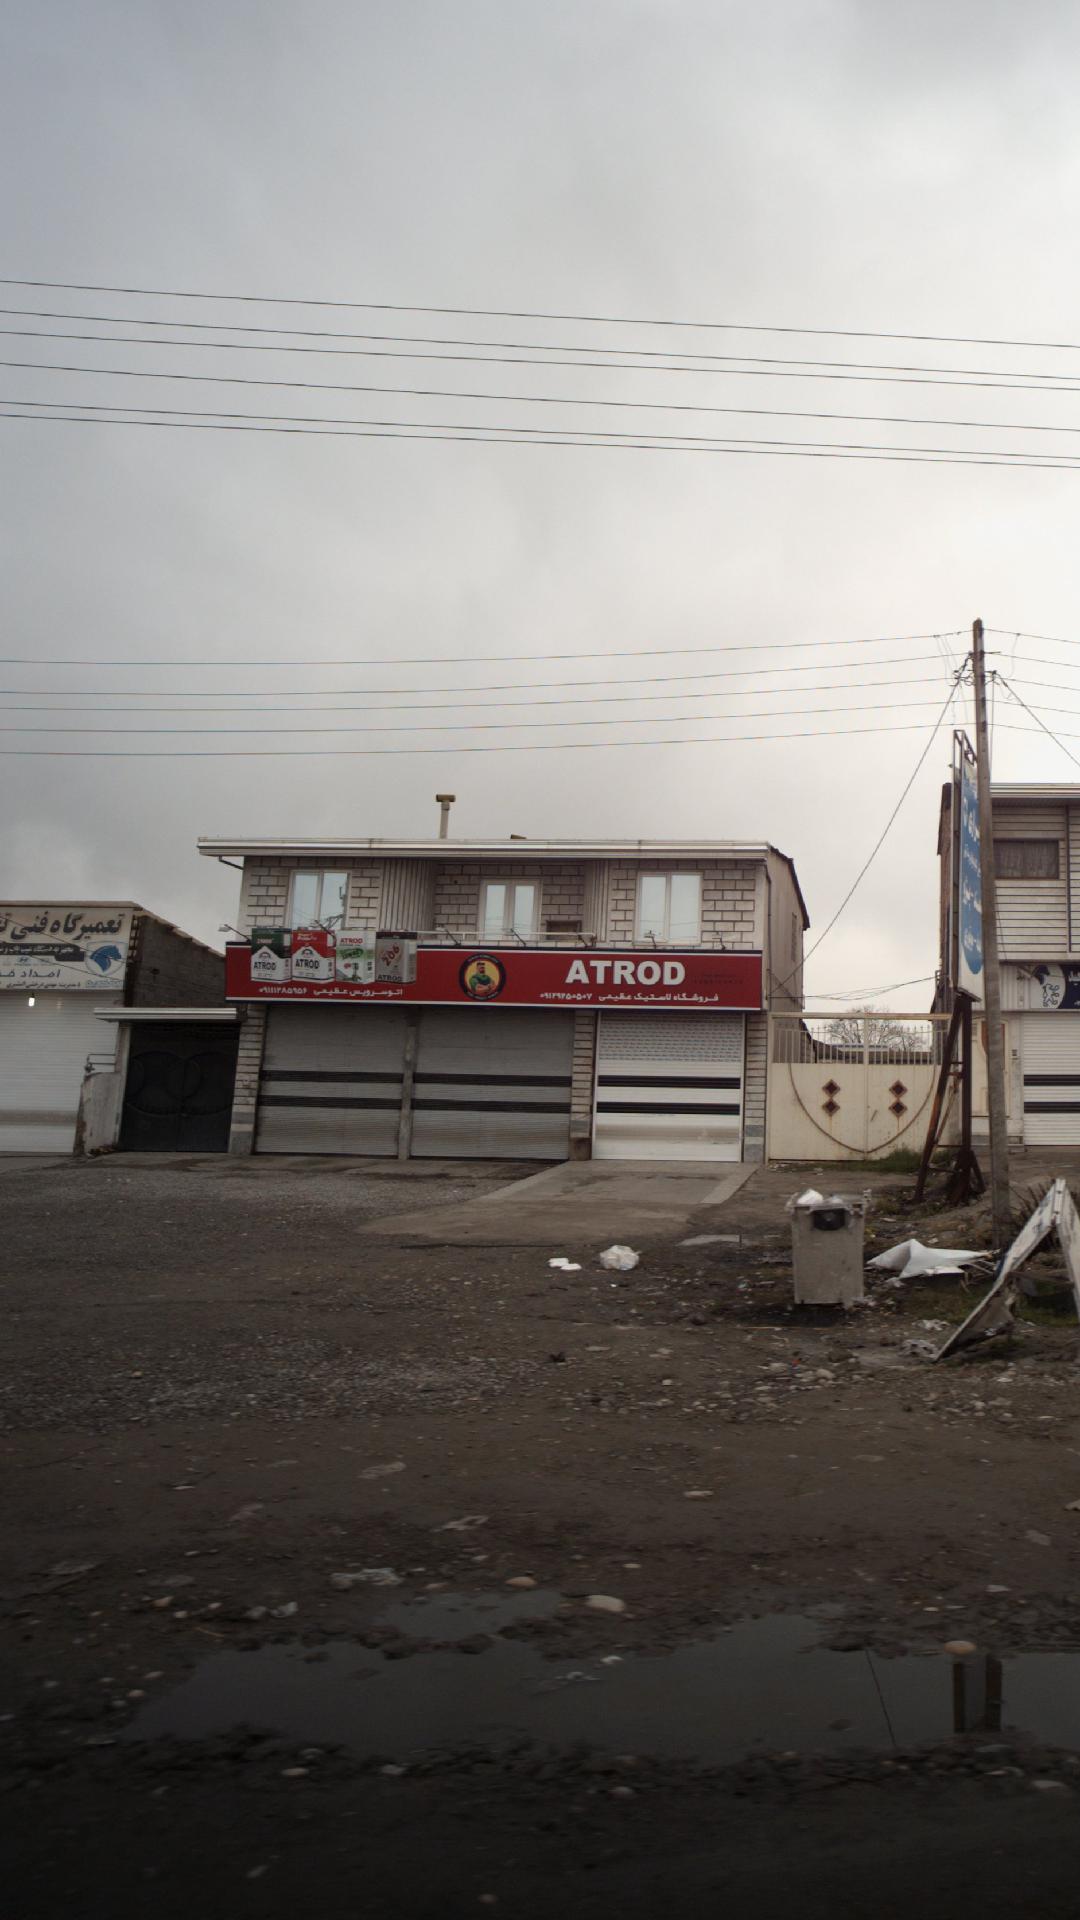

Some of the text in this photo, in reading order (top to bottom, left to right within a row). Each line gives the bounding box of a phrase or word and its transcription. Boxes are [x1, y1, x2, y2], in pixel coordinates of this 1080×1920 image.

[10, 911, 48, 940] فنی
[50, 912, 125, 940] تعمیرگاه
[254, 961, 276, 970] ATROD
[296, 959, 320, 969] ATROD
[565, 959, 686, 985] ATROD
[633, 992, 672, 1001] لاستیک
[673, 992, 719, 1002] فروشگاه
